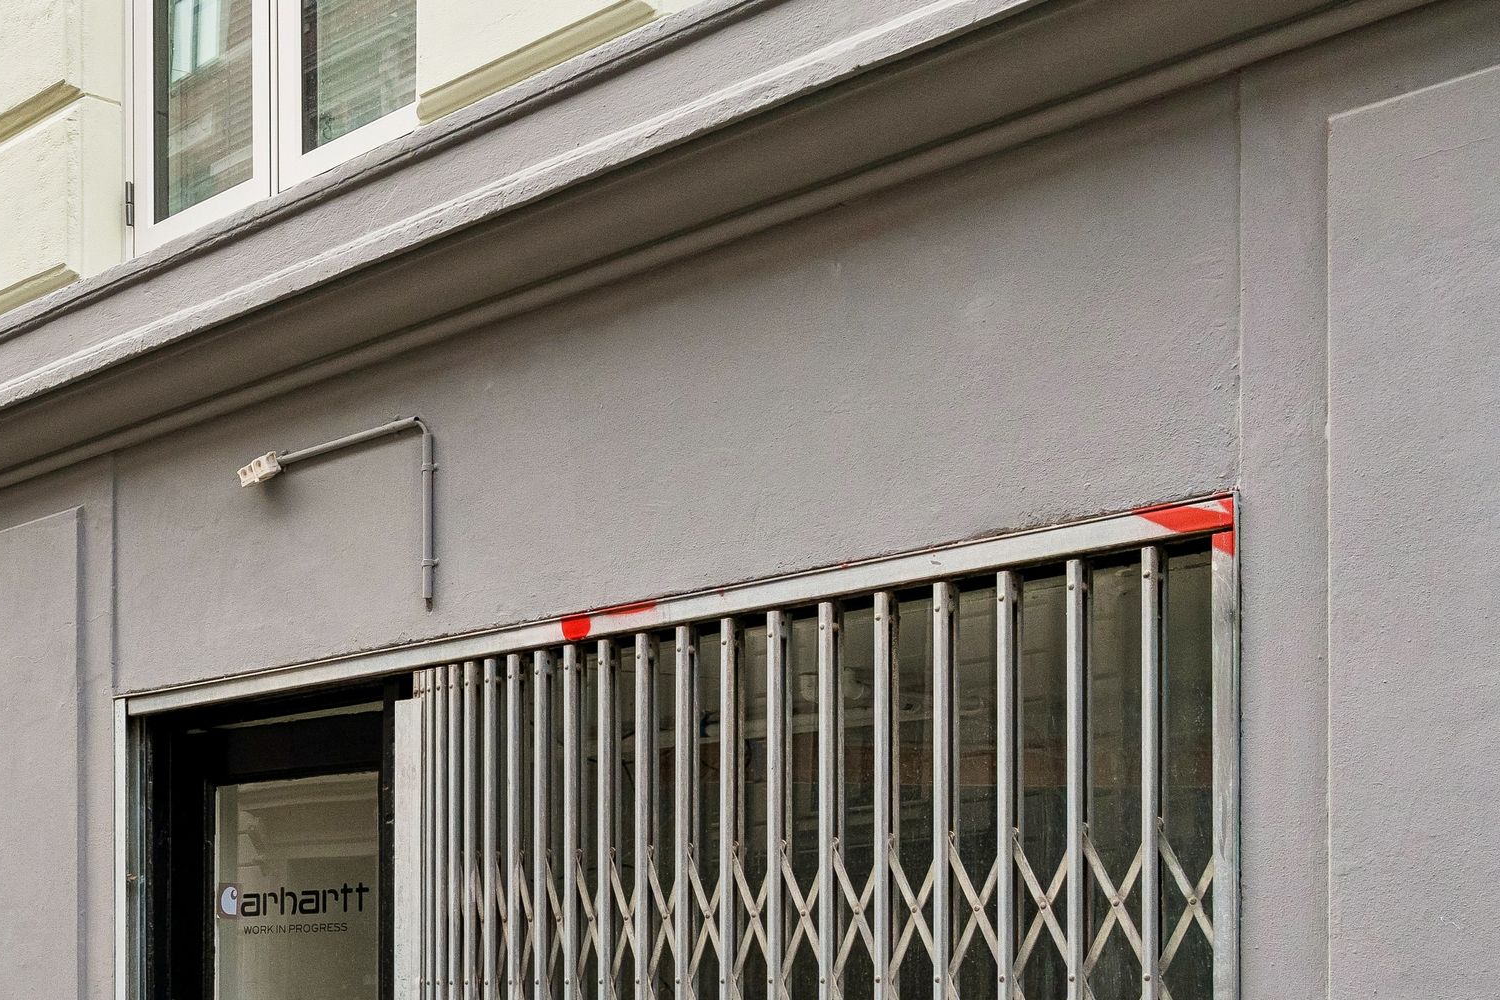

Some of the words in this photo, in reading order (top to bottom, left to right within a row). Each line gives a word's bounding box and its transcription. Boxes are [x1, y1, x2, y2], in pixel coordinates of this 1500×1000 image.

[243, 926, 274, 935] WORK
[276, 925, 287, 934] IN
[288, 923, 348, 933] PROGRESS
